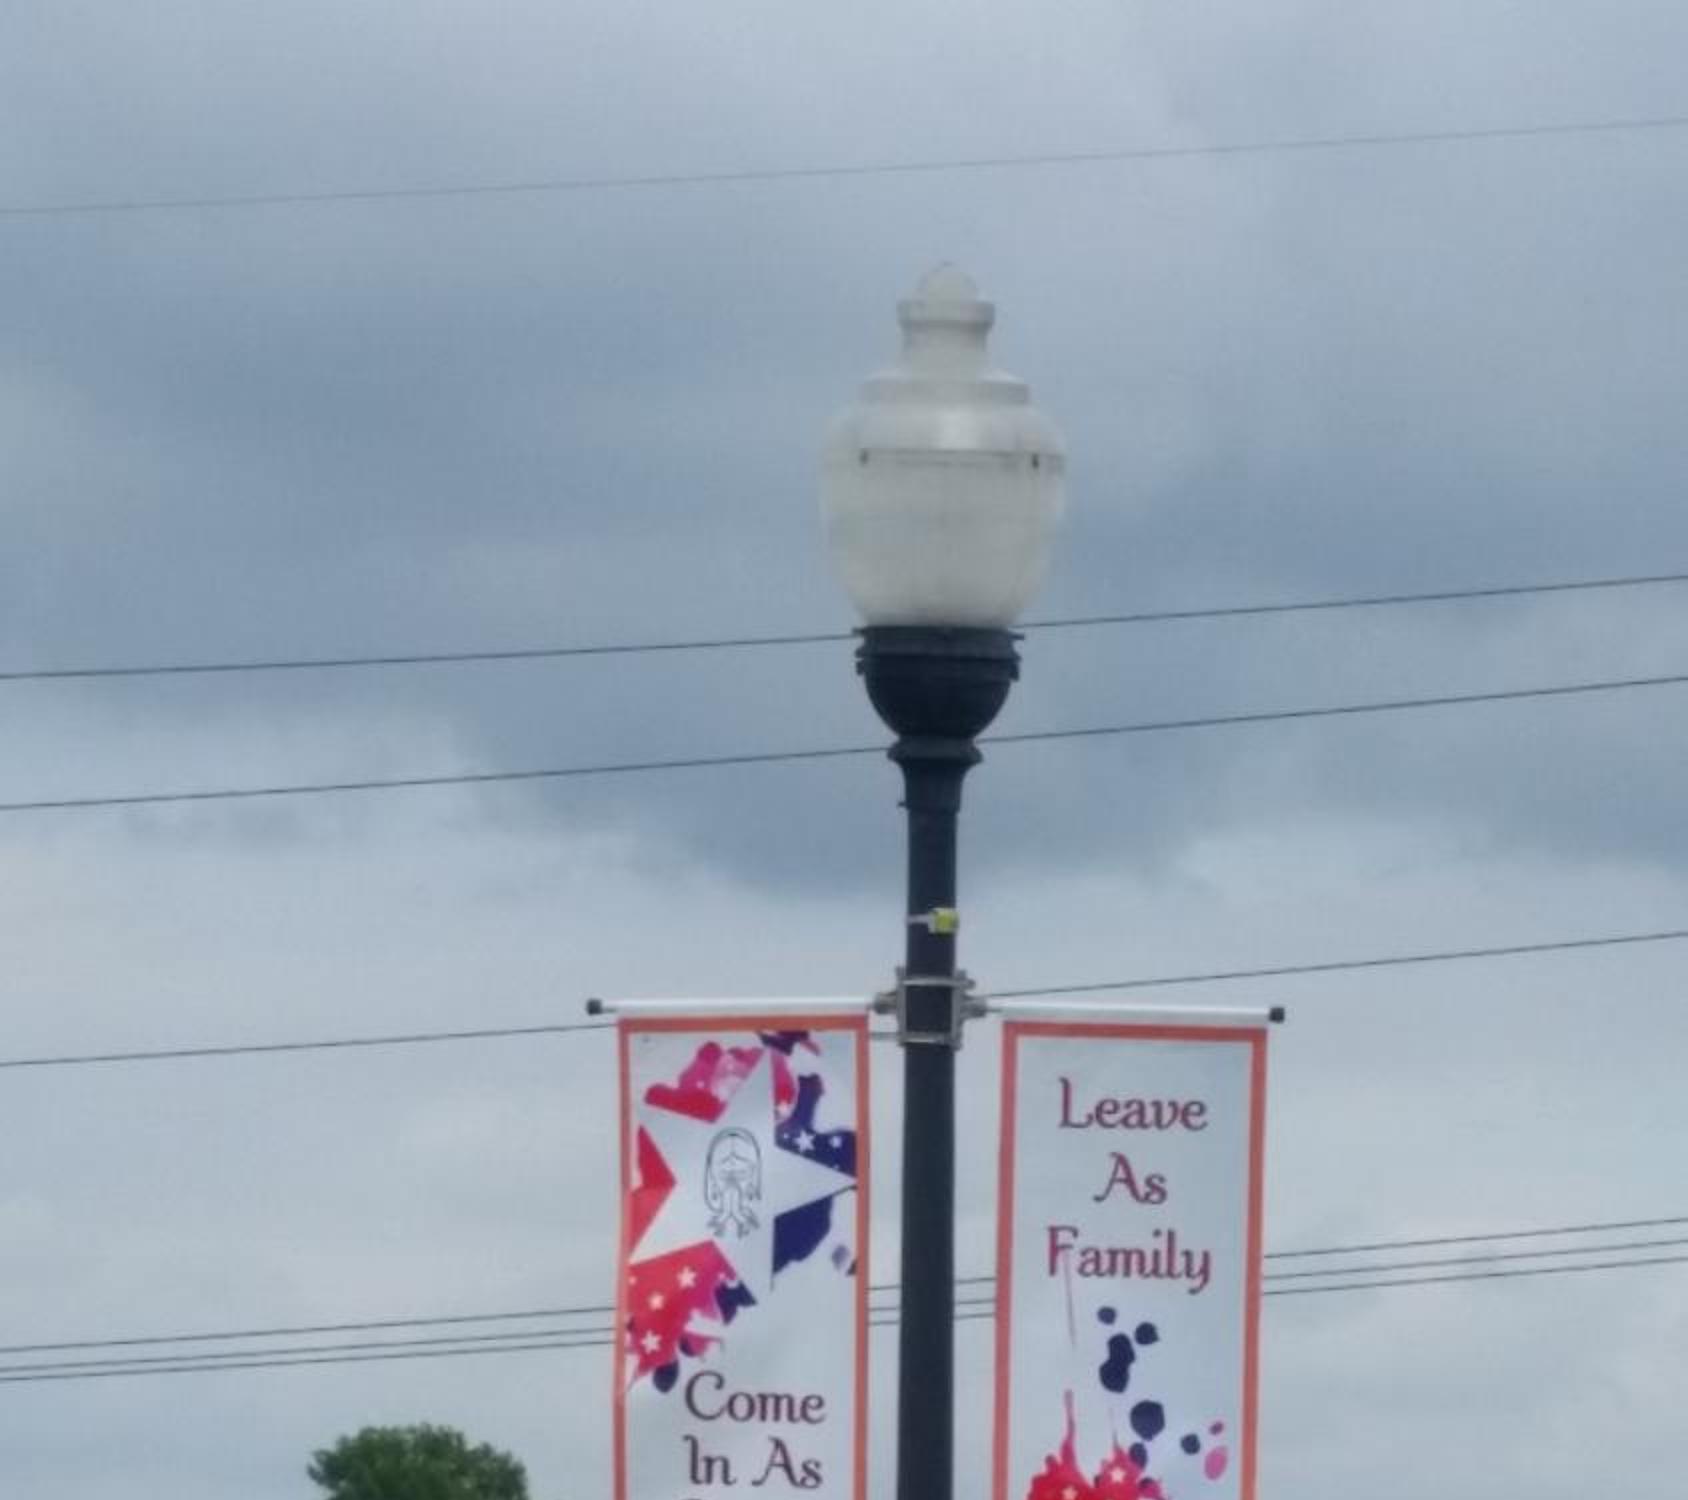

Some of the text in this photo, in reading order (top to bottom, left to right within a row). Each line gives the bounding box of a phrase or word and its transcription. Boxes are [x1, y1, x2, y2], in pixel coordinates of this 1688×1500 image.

[1058, 1076, 1209, 1131] Leave
[1093, 1151, 1168, 1205] As
[1046, 1224, 1212, 1295] Family
[684, 1369, 826, 1424] Come
[682, 1434, 823, 1489] In As
